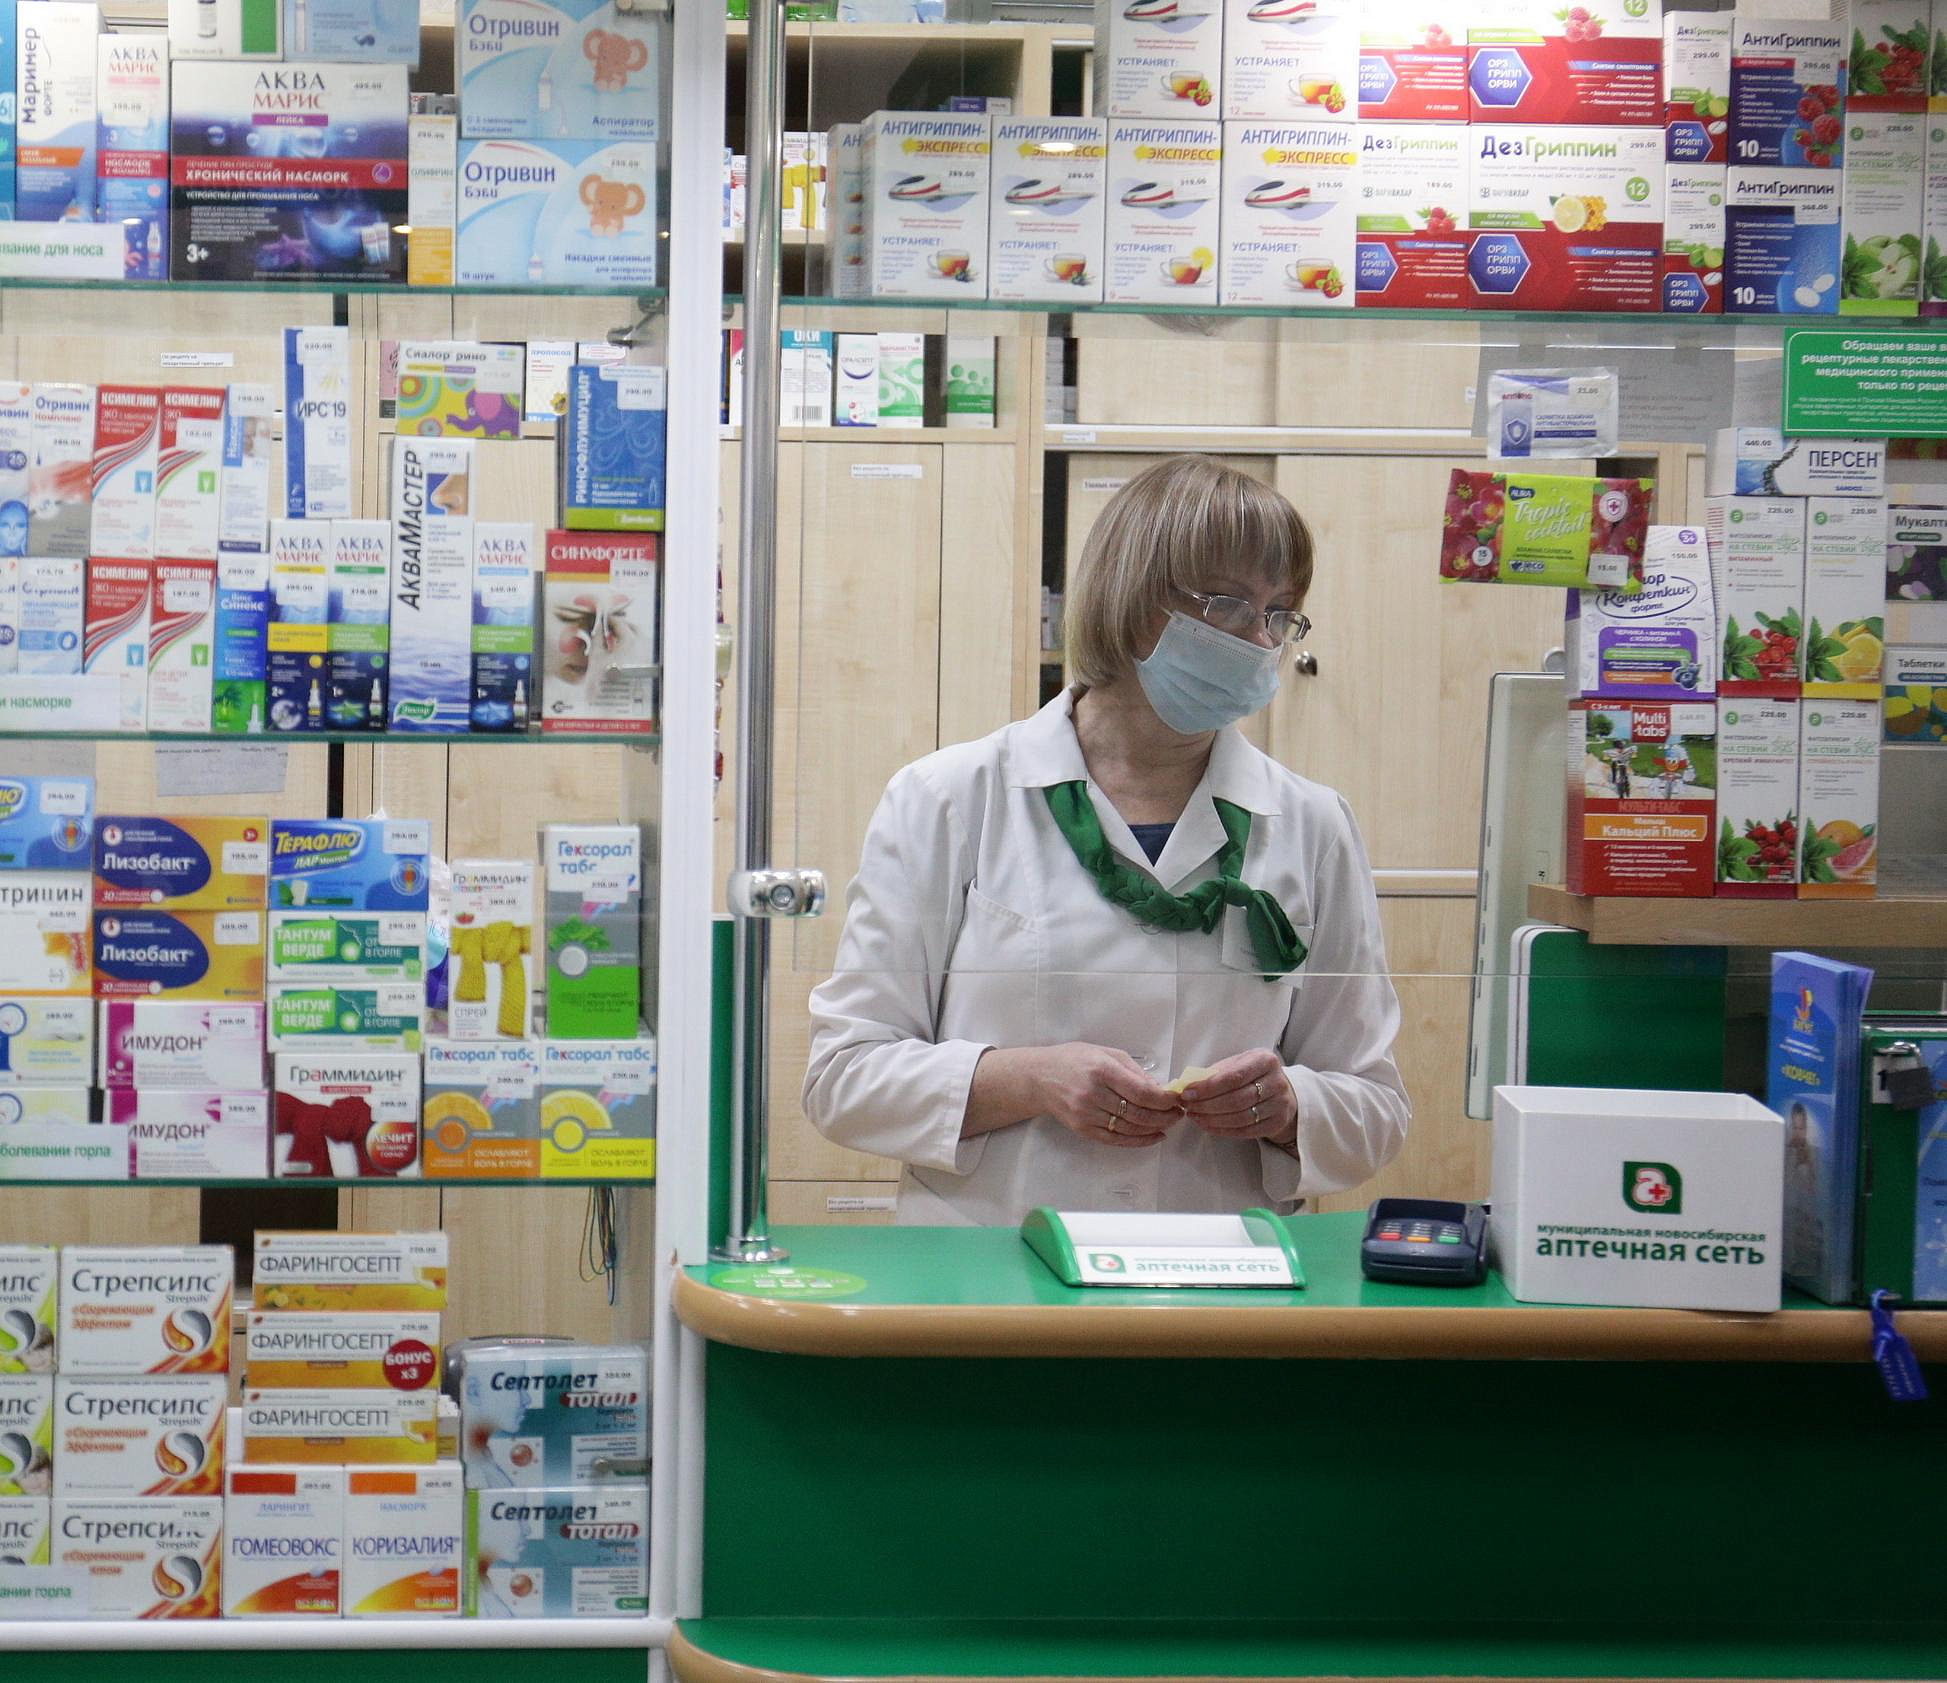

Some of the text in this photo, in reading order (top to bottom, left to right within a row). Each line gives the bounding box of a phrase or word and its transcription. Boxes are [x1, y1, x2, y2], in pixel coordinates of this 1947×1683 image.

[469, 15, 559, 38] Отривин
[469, 39, 503, 52] Бэби
[1742, 32, 1841, 48] АнтиГриппин
[109, 48, 158, 61] АКВА
[110, 61, 156, 73] МАРИС
[1488, 58, 1507, 68] ОРЗ
[22, 27, 41, 124] Маример
[255, 71, 325, 90] АКВА
[1360, 72, 1389, 80] ГРИПП
[1488, 69, 1521, 78] ГРИПП
[1360, 81, 1385, 89] ОРВИ
[1488, 79, 1517, 89] ОРВИ
[253, 92, 321, 109] МАРИС
[592, 116, 654, 129] Аспиратор
[882, 120, 985, 136] АНТИГРИППИН-
[998, 125, 1102, 140] АНТИГРИППИН-
[1115, 128, 1217, 142] АНТИГРИППИН-
[1241, 129, 1352, 146] АНТИГРИППИН-
[1675, 128, 1693, 137] ОРЗ
[914, 141, 983, 154] ЭКСПРЕСС
[1363, 136, 1458, 152] ДезГриппин
[1481, 136, 1617, 162] ДезГриппин
[1674, 138, 1703, 146] ГРИПП
[1737, 139, 1760, 158] 10
[1148, 148, 1214, 161] ЭКСПРЕСС
[1278, 151, 1349, 164] ЭКСПРЕСС
[1674, 148, 1699, 156] ОРВИ
[186, 170, 348, 183] ХРОНИЧЕСКИЙ НАСМОРК
[464, 161, 555, 185] Отривин
[1629, 184, 1646, 196] 12
[1671, 178, 1722, 188] ДезГриппин
[1737, 180, 1835, 197] АнтиГриппин
[465, 188, 499, 199] Бэби
[44, 243, 69, 260] для
[72, 245, 103, 256] носа
[186, 243, 209, 263] 3+
[1362, 250, 1379, 260] ОРЗ
[1488, 244, 1507, 254] ОРЗ
[1361, 259, 1390, 268] ГРИПП
[1487, 255, 1521, 265] ГРИПП
[1361, 268, 1386, 277] ОРВИ
[1487, 265, 1516, 275] ОРВИ
[1671, 279, 1689, 288] ОРЗ
[1671, 289, 1699, 298] ГРИПП
[1733, 286, 1755, 305] 10
[1671, 299, 1694, 307] ОРВИ
[1842, 340, 1904, 351] Обращаем
[1906, 342, 1937, 351] ваше
[405, 349, 487, 365] Сиалор рино
[1801, 354, 1879, 365] рецептурные
[1815, 367, 1898, 378] медицинского
[1857, 381, 1915, 390] только по
[35, 396, 90, 413] Отривин
[101, 392, 158, 408] КСИМЕЛИН
[164, 392, 221, 408] КСИМЕЛИН
[297, 400, 346, 417] ИРС 19
[1809, 450, 1878, 468] ПЕРСЕН
[1514, 496, 1573, 522] Tropic
[1525, 517, 1586, 542] cocktail
[277, 537, 323, 550] АКВА
[336, 537, 384, 551] АКВА
[481, 537, 527, 552] АКВА
[274, 551, 321, 563] МАРИС
[335, 551, 381, 562] МАРИС
[479, 553, 525, 565] МАРИС
[551, 545, 646, 561] СИНУФОРТЕ
[92, 566, 148, 580] КСИМЕЛИН
[157, 566, 213, 580] КСИМЕЛИН
[1603, 584, 1691, 608] Конфеткин
[221, 599, 264, 611] Синекс
[1630, 602, 1664, 614] форте
[1897, 658, 1946, 669] Таблетки
[11, 697, 72, 709] насморке
[1633, 711, 1667, 725] Multi
[1602, 825, 1697, 839] Кальций Плюс
[275, 830, 361, 855] ТЕРАФЛЮ
[558, 840, 632, 857] Гексорал
[103, 852, 191, 872] Лизобакт
[560, 860, 597, 874] табс
[275, 929, 331, 942] ТАНТУМ
[101, 944, 189, 966] Лизобакт
[282, 943, 325, 958] ВЕРДЕ
[275, 999, 331, 1013] ТАНТУМ
[281, 1014, 325, 1028] ВЕРДЕ
[121, 1035, 203, 1053] ИМУДОН
[429, 1047, 534, 1063] Гексорал табс
[545, 1047, 650, 1063] Гексорал табс
[290, 1066, 401, 1083] Граммидин
[73, 1145, 112, 1160] горла
[1537, 1223, 1766, 1243] муниципальная новосибирская
[1536, 1238, 1765, 1265] аптечная сеть
[259, 1255, 402, 1274] ФАРИНГОСЕПТ
[1136, 1261, 1281, 1273] аптечная сеть
[71, 1268, 216, 1298] Стрепсилс
[251, 1333, 394, 1351] ФАРИНГОСЕПТ
[385, 1352, 431, 1366] БОНУС
[400, 1367, 418, 1380] х3
[491, 1371, 598, 1391] Септолет
[65, 1391, 209, 1420] Стрепсилс
[566, 1392, 630, 1408] тотал
[248, 1410, 389, 1428] ФАРИНГОСЕПТ
[491, 1501, 597, 1522] Септолет
[566, 1523, 634, 1540] тотал
[231, 1537, 337, 1557] ГОМЕОВОКС
[352, 1535, 454, 1556] КОРИЗАЛИЯ
[35, 1587, 72, 1600] горла
